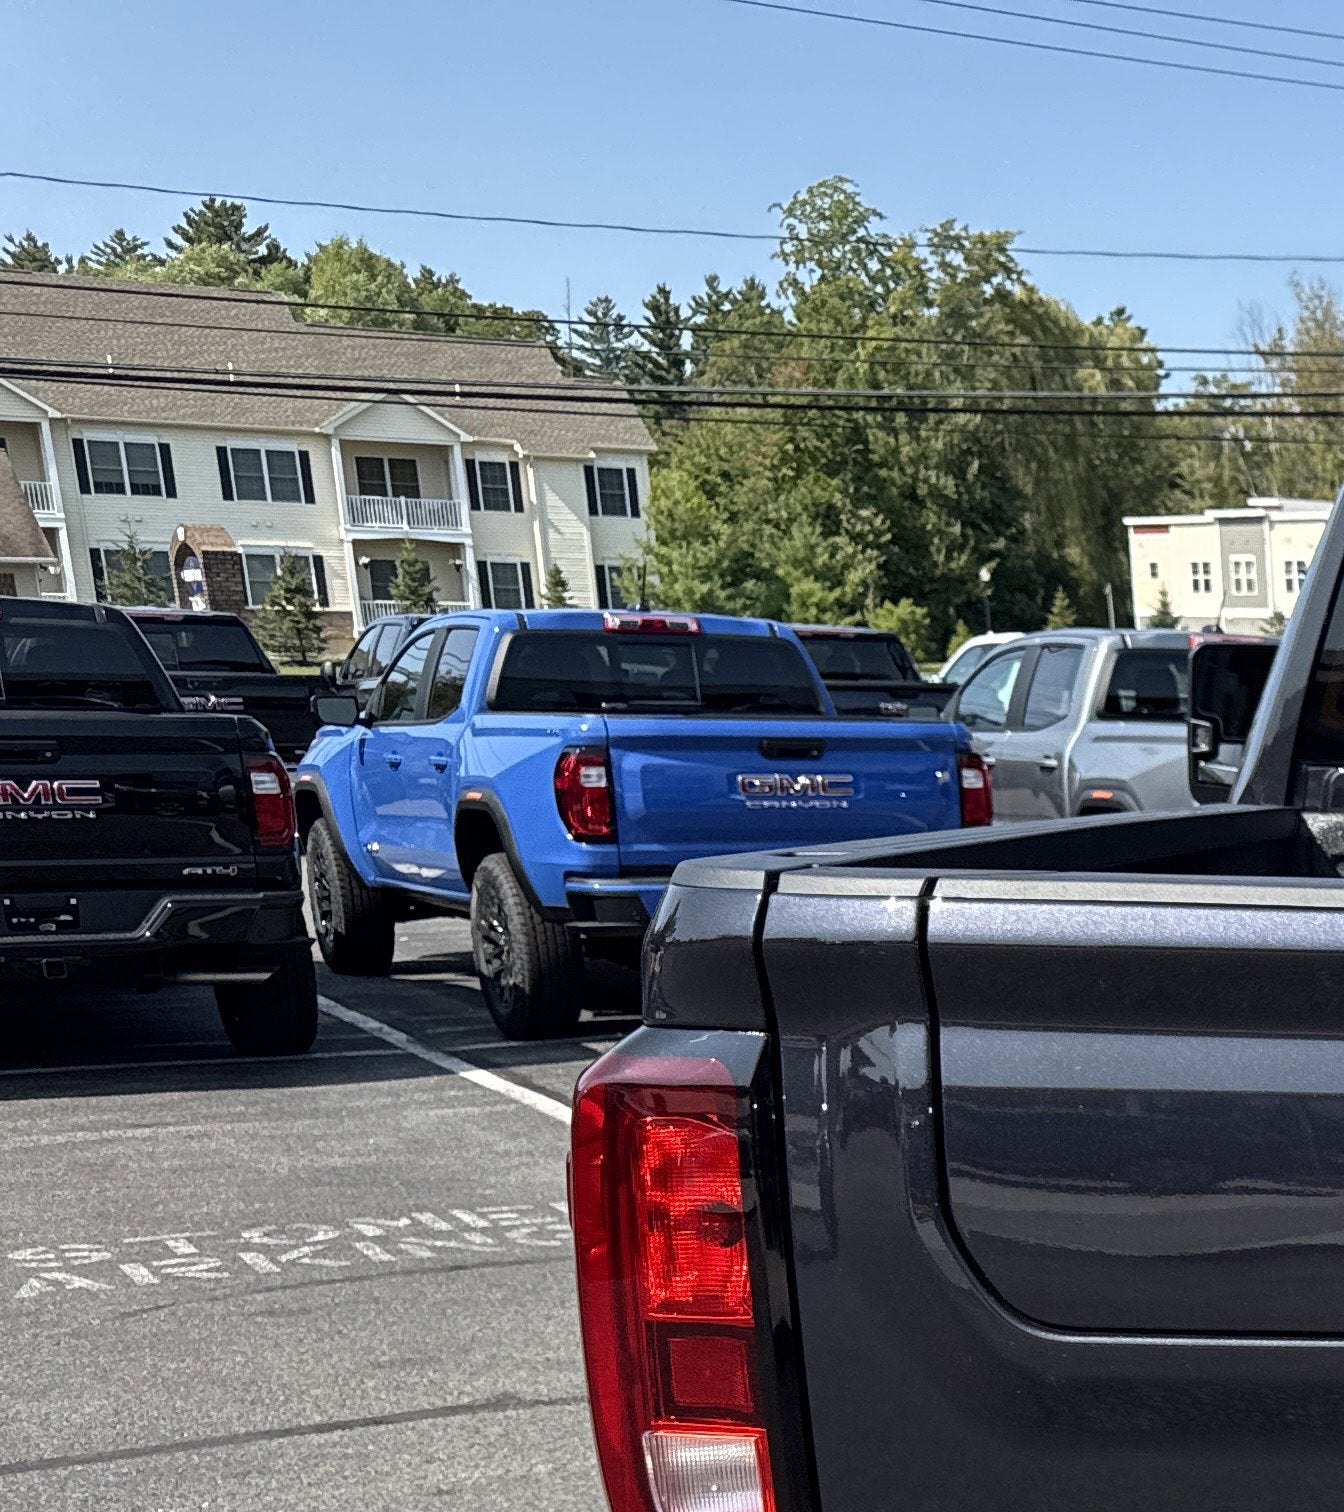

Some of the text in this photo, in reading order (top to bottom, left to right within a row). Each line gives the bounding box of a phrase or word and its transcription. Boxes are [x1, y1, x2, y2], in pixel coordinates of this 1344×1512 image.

[0, 780, 102, 804] MC
[737, 774, 853, 796] GMC
[0, 810, 96, 819] NYON
[745, 800, 849, 808] CANYON
[6, 1201, 569, 1268] STOME
[12, 1224, 574, 1298] ARKING
